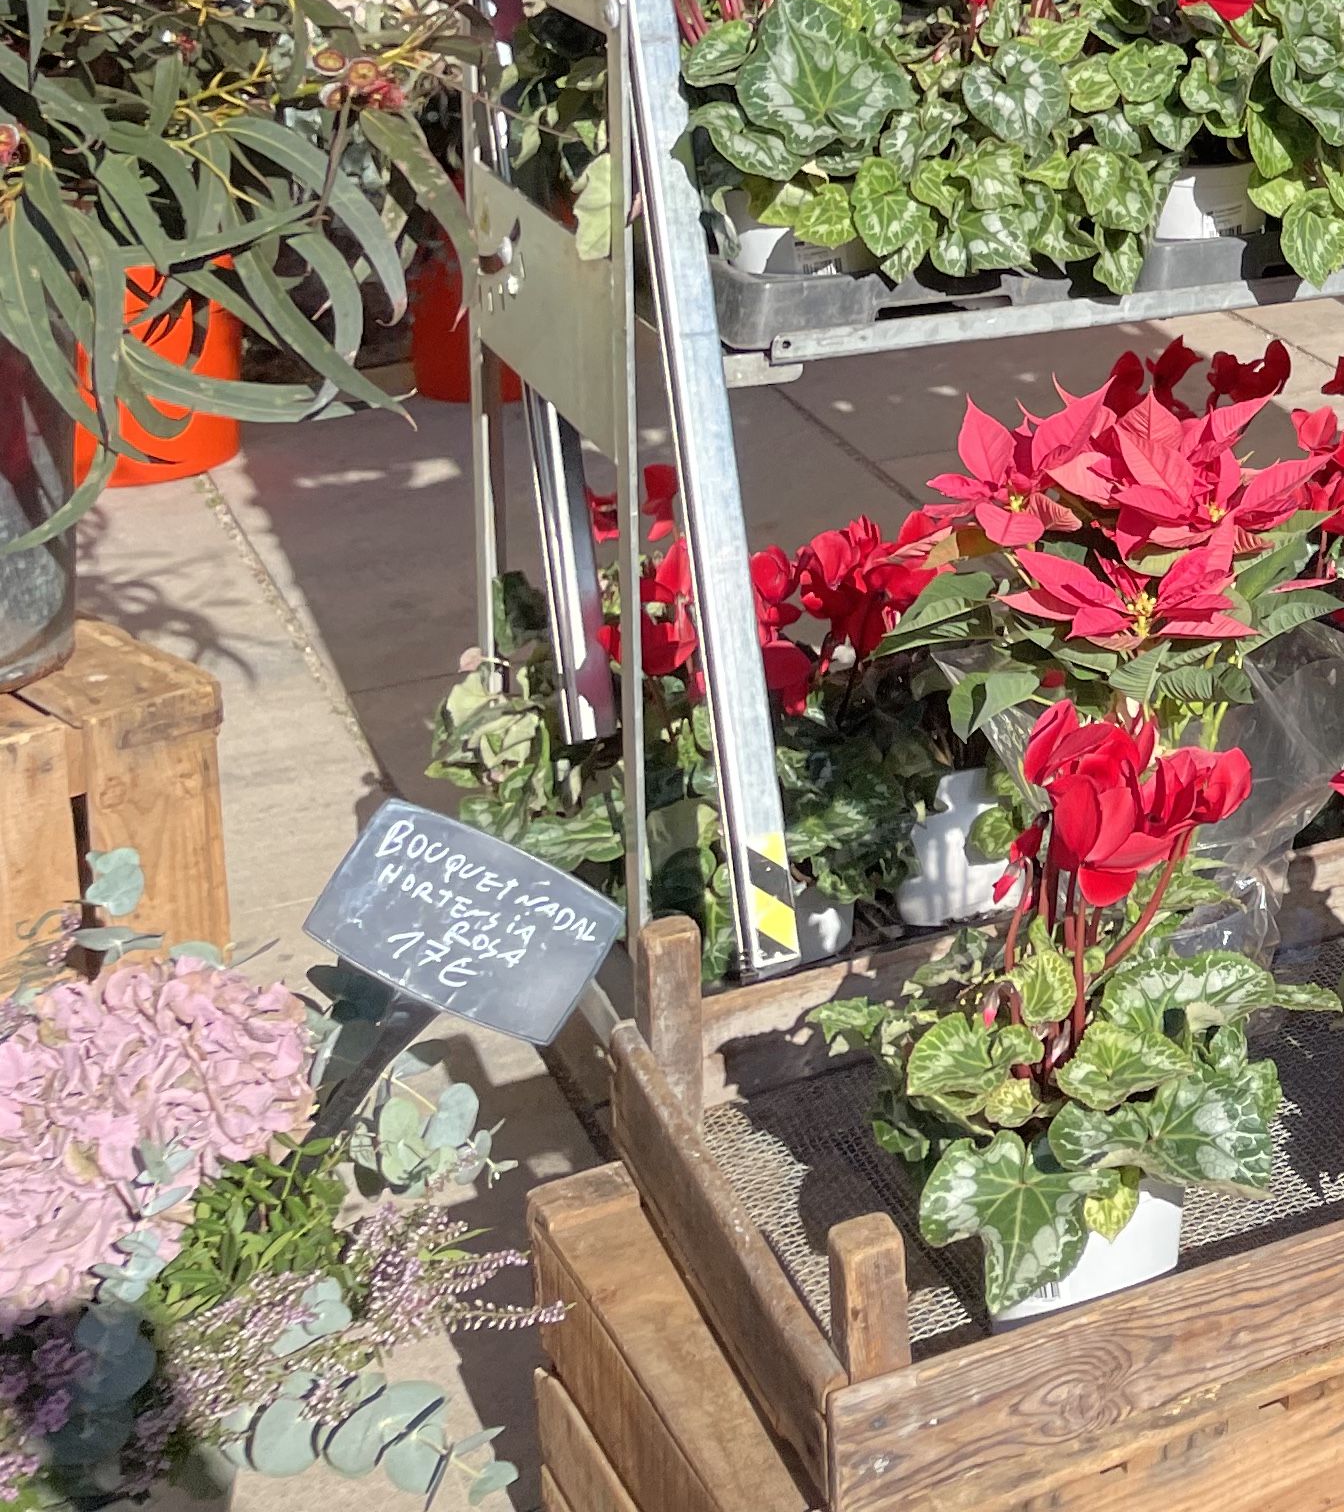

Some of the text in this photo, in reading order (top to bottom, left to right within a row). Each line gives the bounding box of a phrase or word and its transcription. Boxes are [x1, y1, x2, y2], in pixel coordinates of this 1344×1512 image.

[376, 819, 598, 942] BOUQUET NADAL
[387, 931, 478, 989] 17€
[443, 920, 527, 969] ROSA
